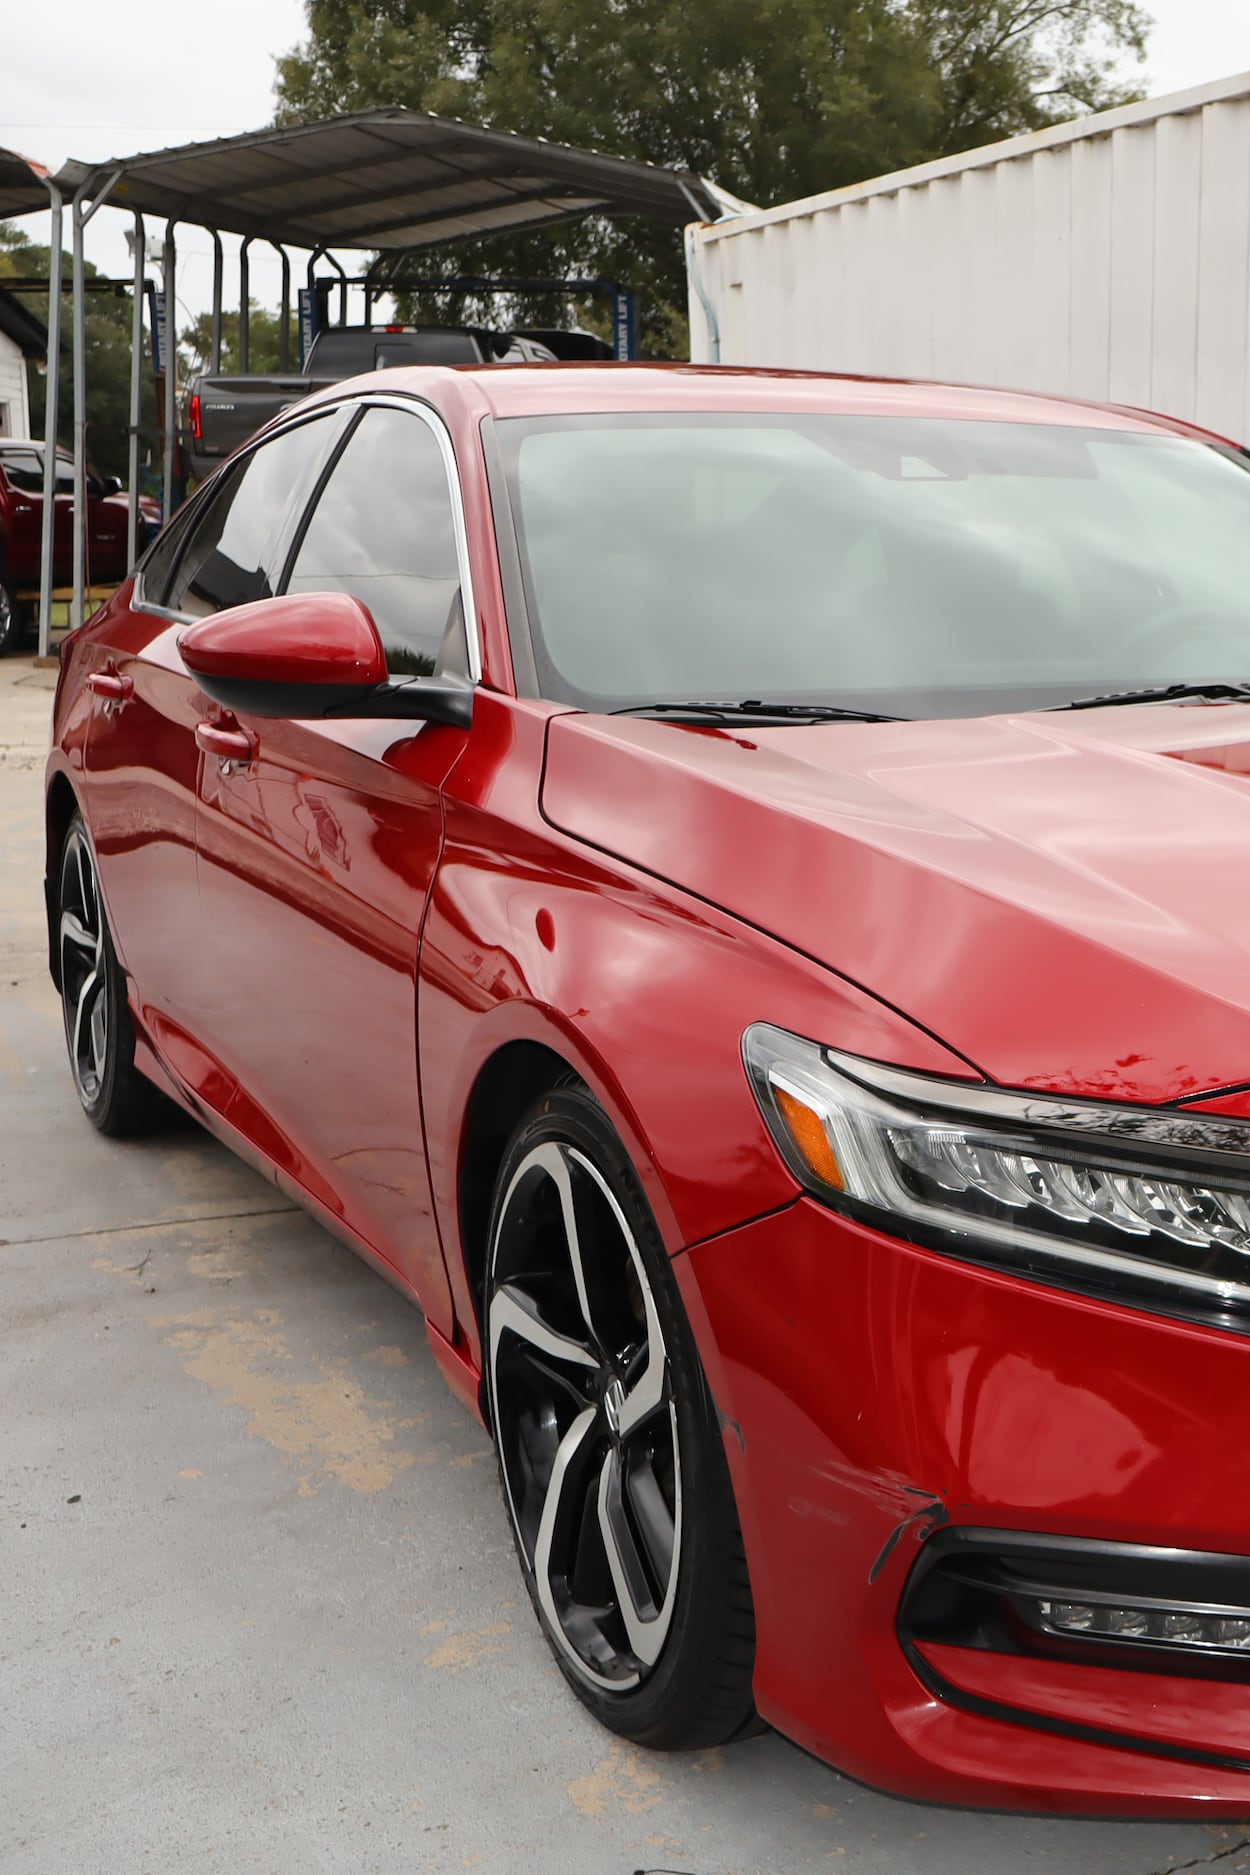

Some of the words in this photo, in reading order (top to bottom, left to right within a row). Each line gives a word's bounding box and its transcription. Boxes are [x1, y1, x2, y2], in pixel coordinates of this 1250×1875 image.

[301, 290, 312, 315] LIFT
[617, 294, 628, 320] LIFT
[618, 322, 628, 361] OTARY
